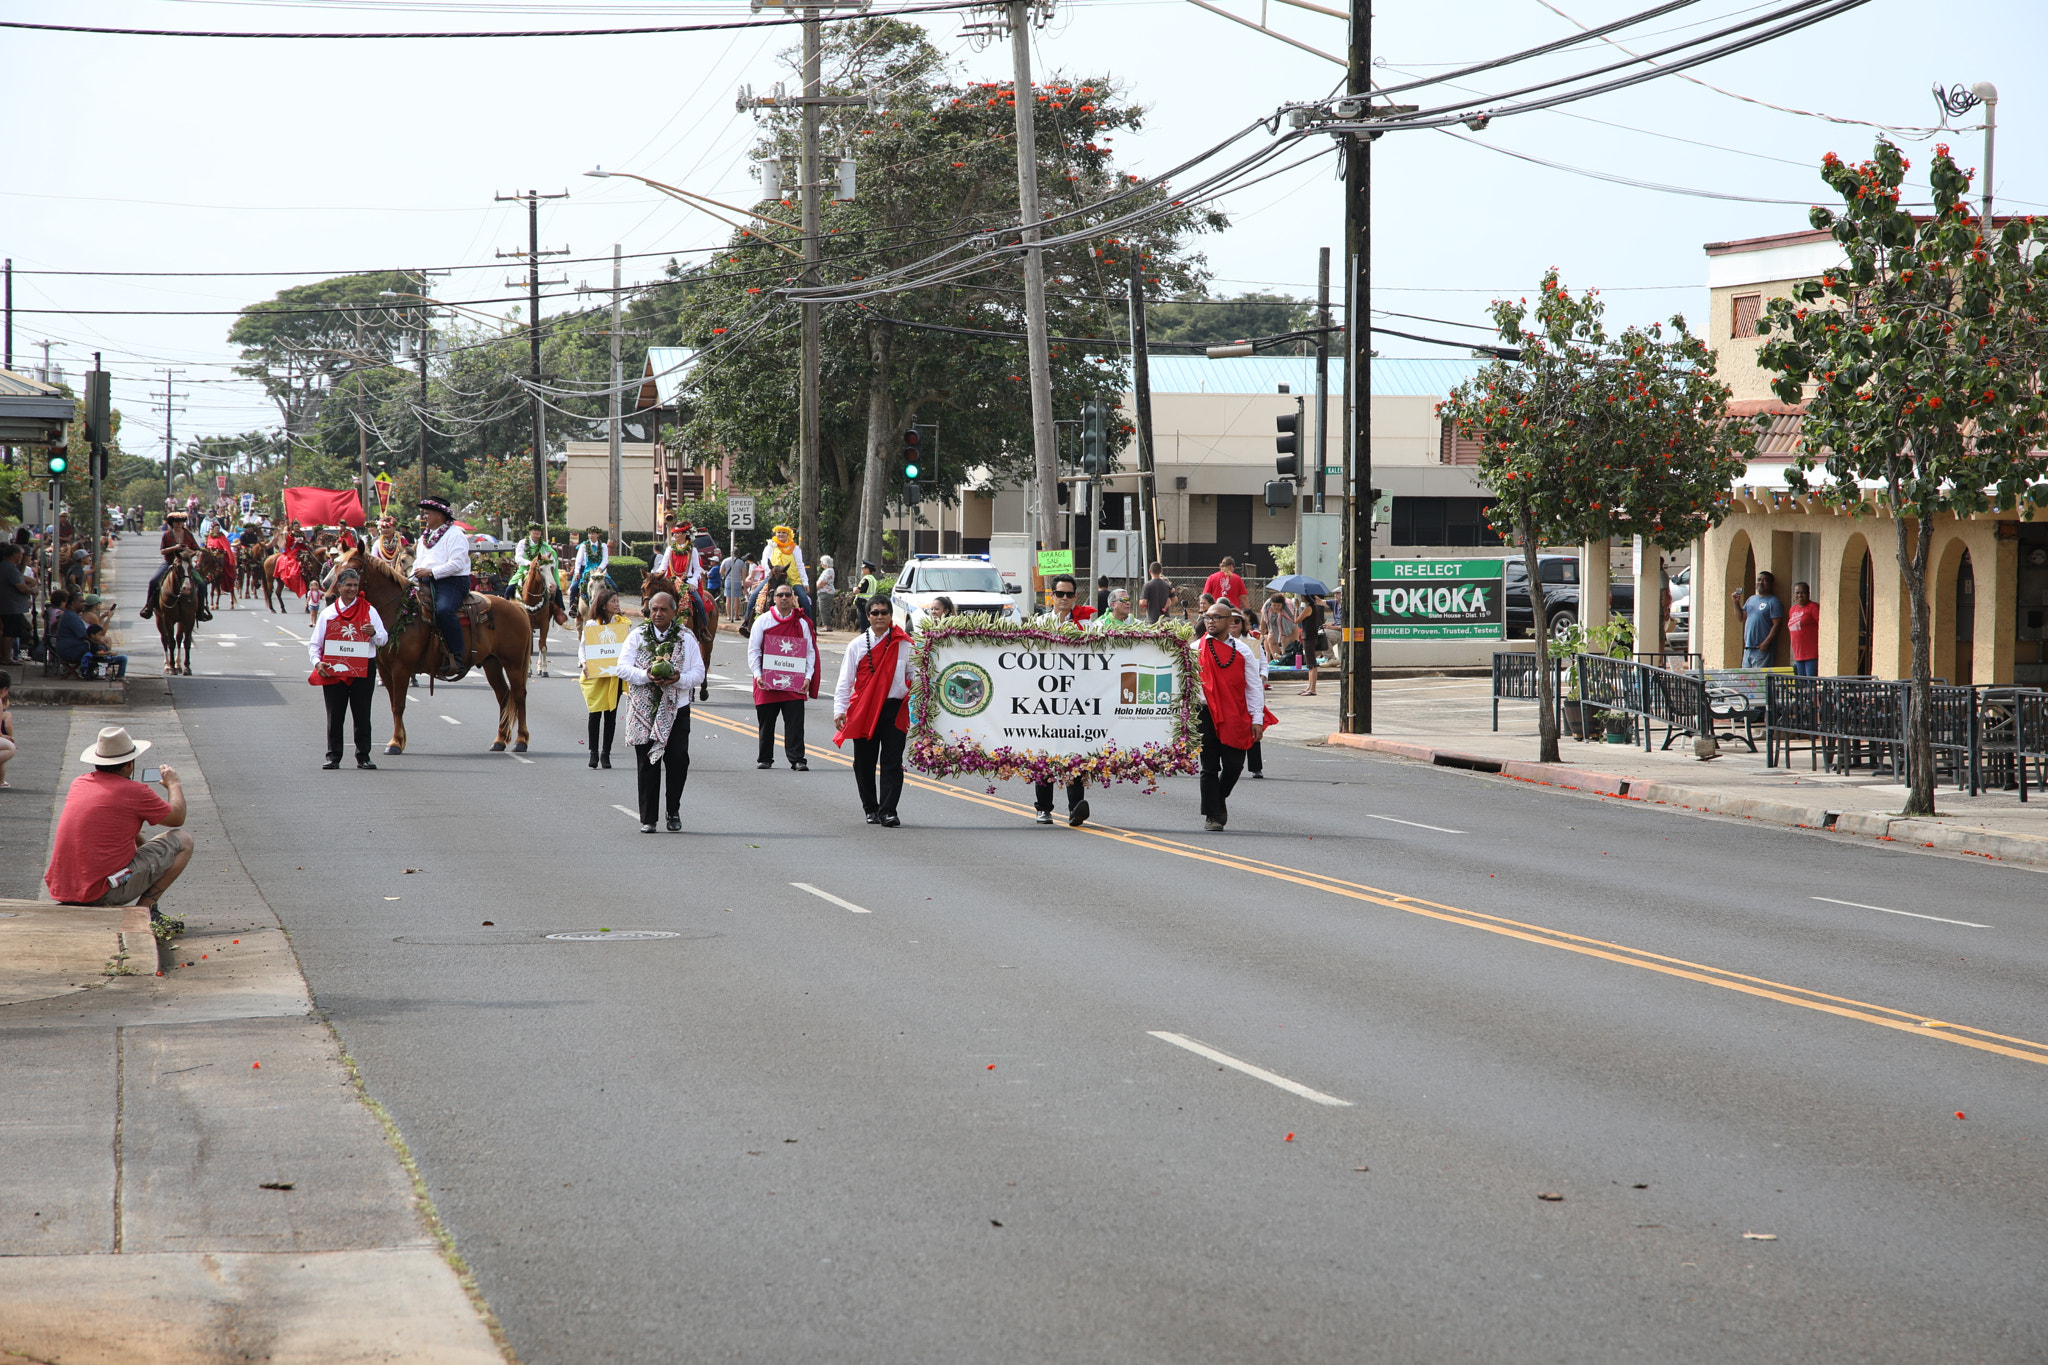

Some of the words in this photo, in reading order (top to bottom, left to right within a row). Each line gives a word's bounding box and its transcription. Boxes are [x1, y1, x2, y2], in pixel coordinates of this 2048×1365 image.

[731, 514, 752, 525] 25
[1394, 564, 1462, 576] RE-ELECT
[1372, 587, 1487, 613] TOKIOKA
[1413, 627, 1440, 635] Proven.
[1442, 626, 1471, 634] Trusted.
[1474, 626, 1500, 634] Tested.
[998, 651, 1115, 670] COUNTY
[1038, 675, 1075, 693] OF
[1114, 707, 1134, 715] Holo
[1135, 707, 1155, 715] Holo
[1003, 724, 1109, 742] www.kauai.gov
